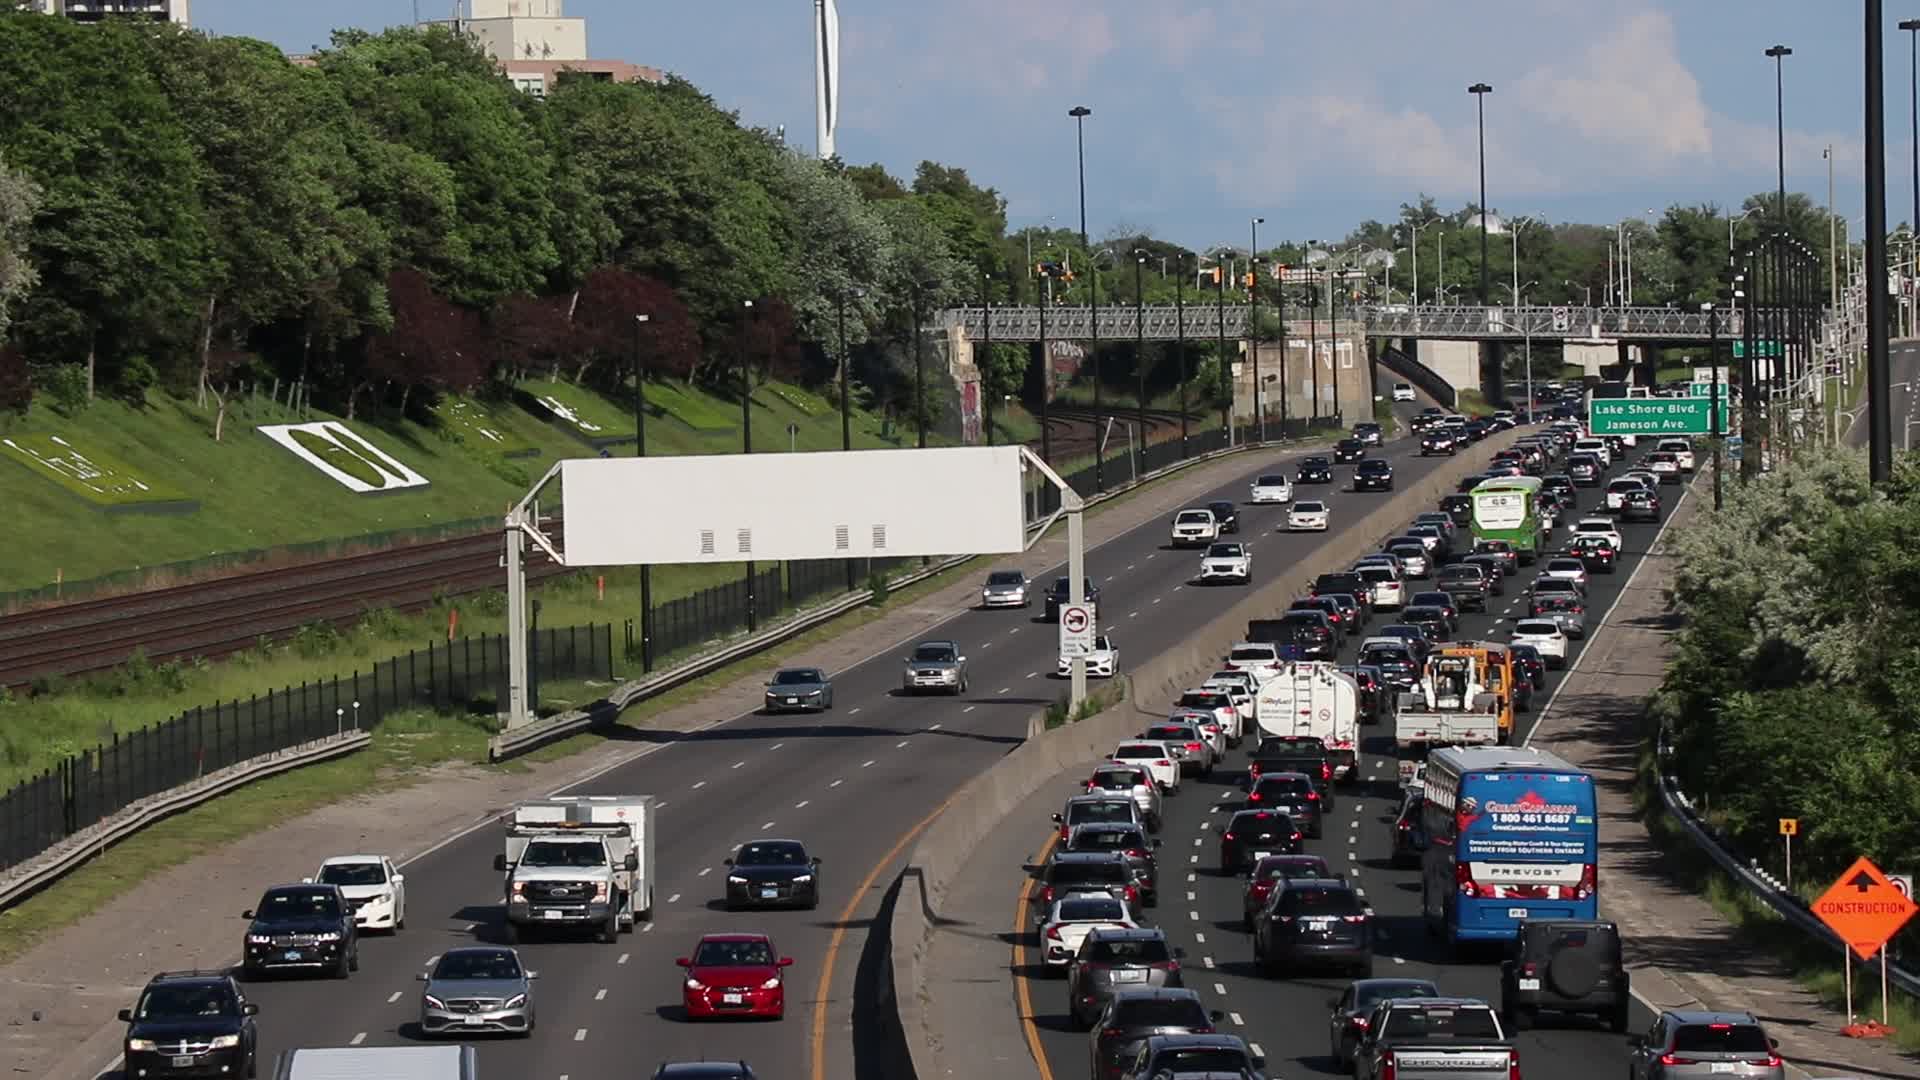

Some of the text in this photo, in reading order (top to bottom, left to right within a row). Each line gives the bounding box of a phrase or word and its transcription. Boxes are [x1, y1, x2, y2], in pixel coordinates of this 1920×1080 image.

[1595, 404, 1699, 414] Lake Shore Blvd.
[1605, 420, 1688, 430] Jameson Ave.
[1491, 813, 1498, 823] 1
[1500, 813, 1520, 823] 800
[1522, 814, 1542, 824] 461
[1544, 814, 1570, 824] 8687
[1490, 868, 1562, 876] PREVOST
[1820, 902, 1906, 914] CONSTRUCTION
